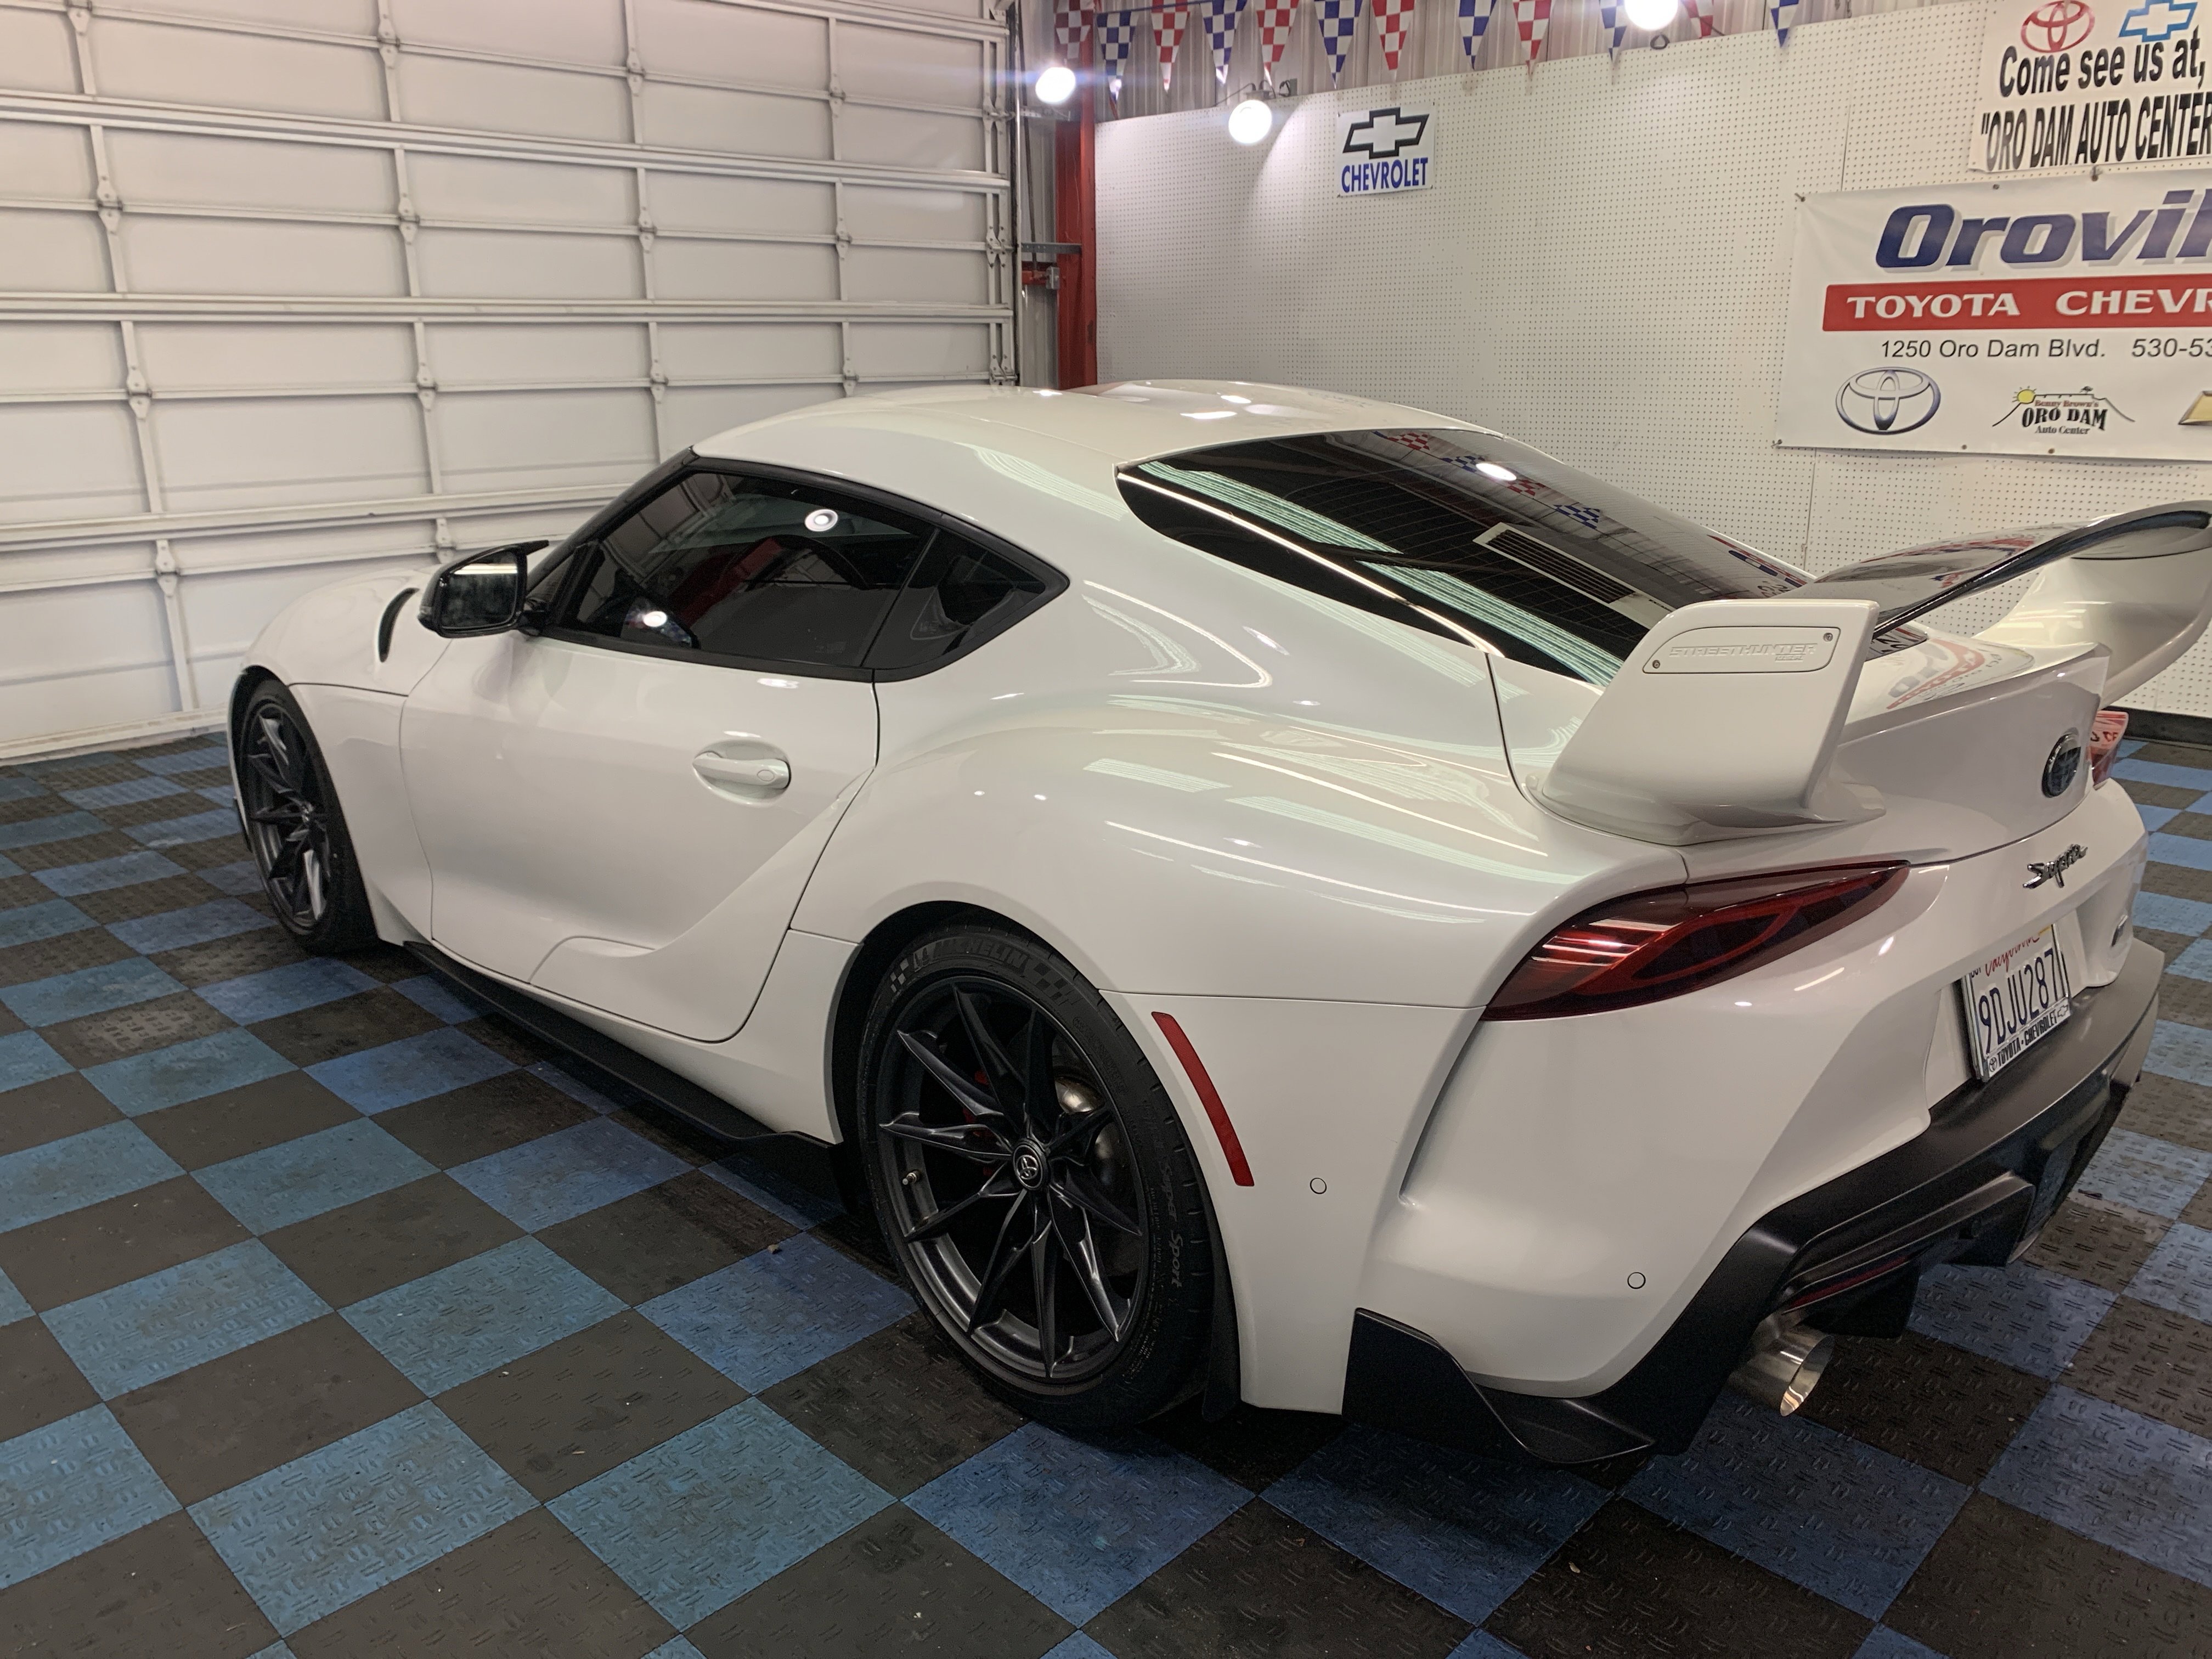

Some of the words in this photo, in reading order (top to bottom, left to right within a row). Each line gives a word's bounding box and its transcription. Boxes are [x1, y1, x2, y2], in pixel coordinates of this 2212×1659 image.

[2000, 45, 2071, 97] Come
[2078, 46, 2125, 89] see
[2134, 42, 2164, 83] us
[2172, 24, 2206, 89] at,
[2075, 98, 2131, 165] AUTO
[1341, 157, 1429, 193] CHEVROLET
[1847, 292, 2021, 319] TOYOTA
[1882, 340, 1931, 358] 1250
[1939, 339, 1978, 358] Oro
[1987, 338, 2039, 357] Dam
[2048, 337, 2106, 358] Blvd.
[2022, 407, 2061, 428] ORO
[2067, 408, 2108, 431] DAM
[2035, 399, 2061, 408] Benny
[2034, 425, 2057, 434] Auto
[2059, 425, 2090, 435] Center
[1978, 947, 2058, 1055] 9DJU287
[1996, 1037, 2022, 1066] TOYOTA
[2024, 1009, 2058, 1046] CHEVROLET
[1169, 1229, 1183, 1288] Sport
